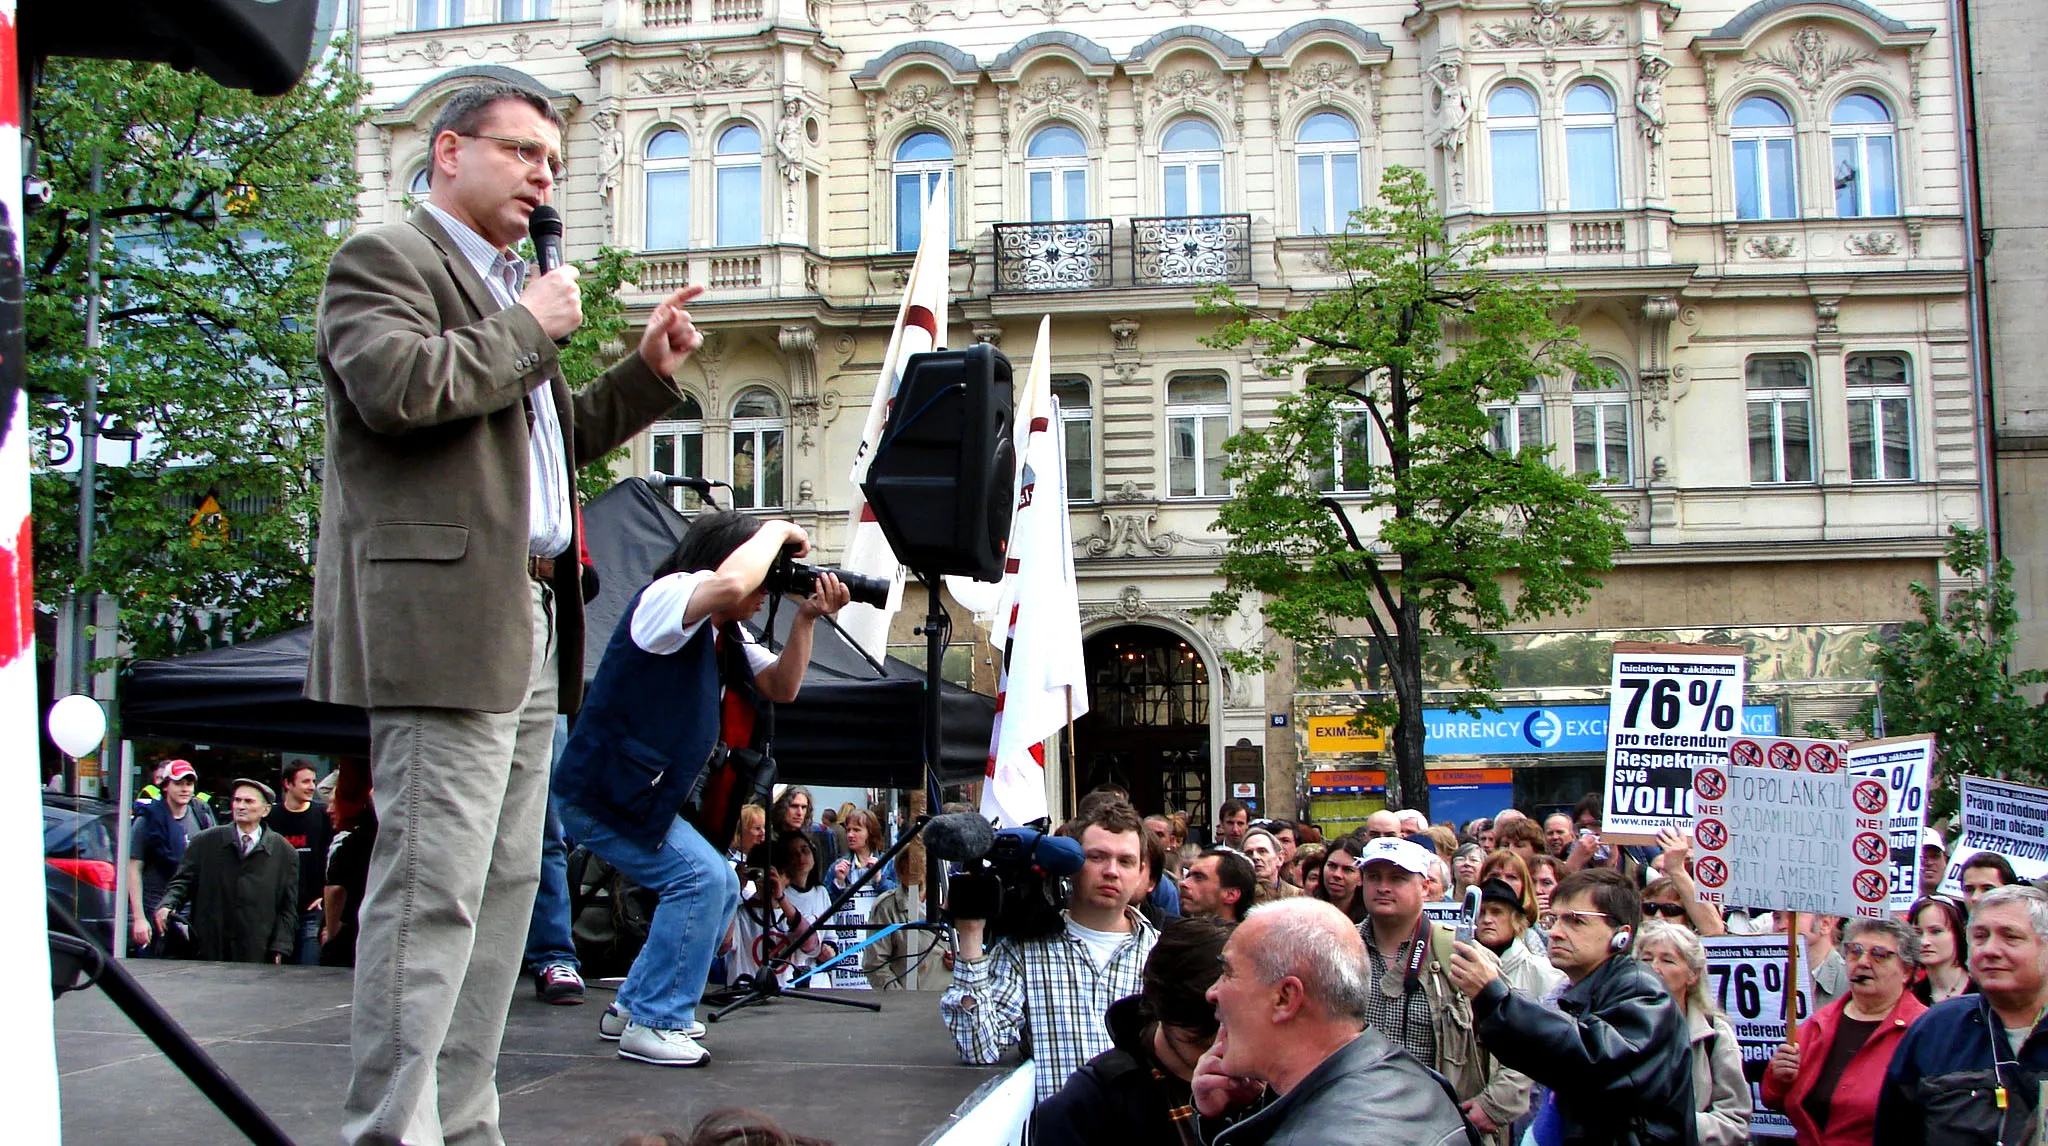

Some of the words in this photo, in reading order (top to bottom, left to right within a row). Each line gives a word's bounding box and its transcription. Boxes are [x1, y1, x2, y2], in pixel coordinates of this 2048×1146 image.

[1621, 664, 1665, 673] Iniciativa
[1667, 665, 1680, 673] Ne
[1683, 666, 1735, 675] základnám
[1615, 734, 1639, 746] pro
[1614, 767, 1648, 783] své
[1966, 793, 1994, 812] Právo
[1698, 804, 1723, 816] NE!
[1856, 818, 1883, 830] NE!
[1990, 815, 2006, 831] jen
[1700, 891, 1725, 903] NE!
[1856, 906, 1884, 918] NE!
